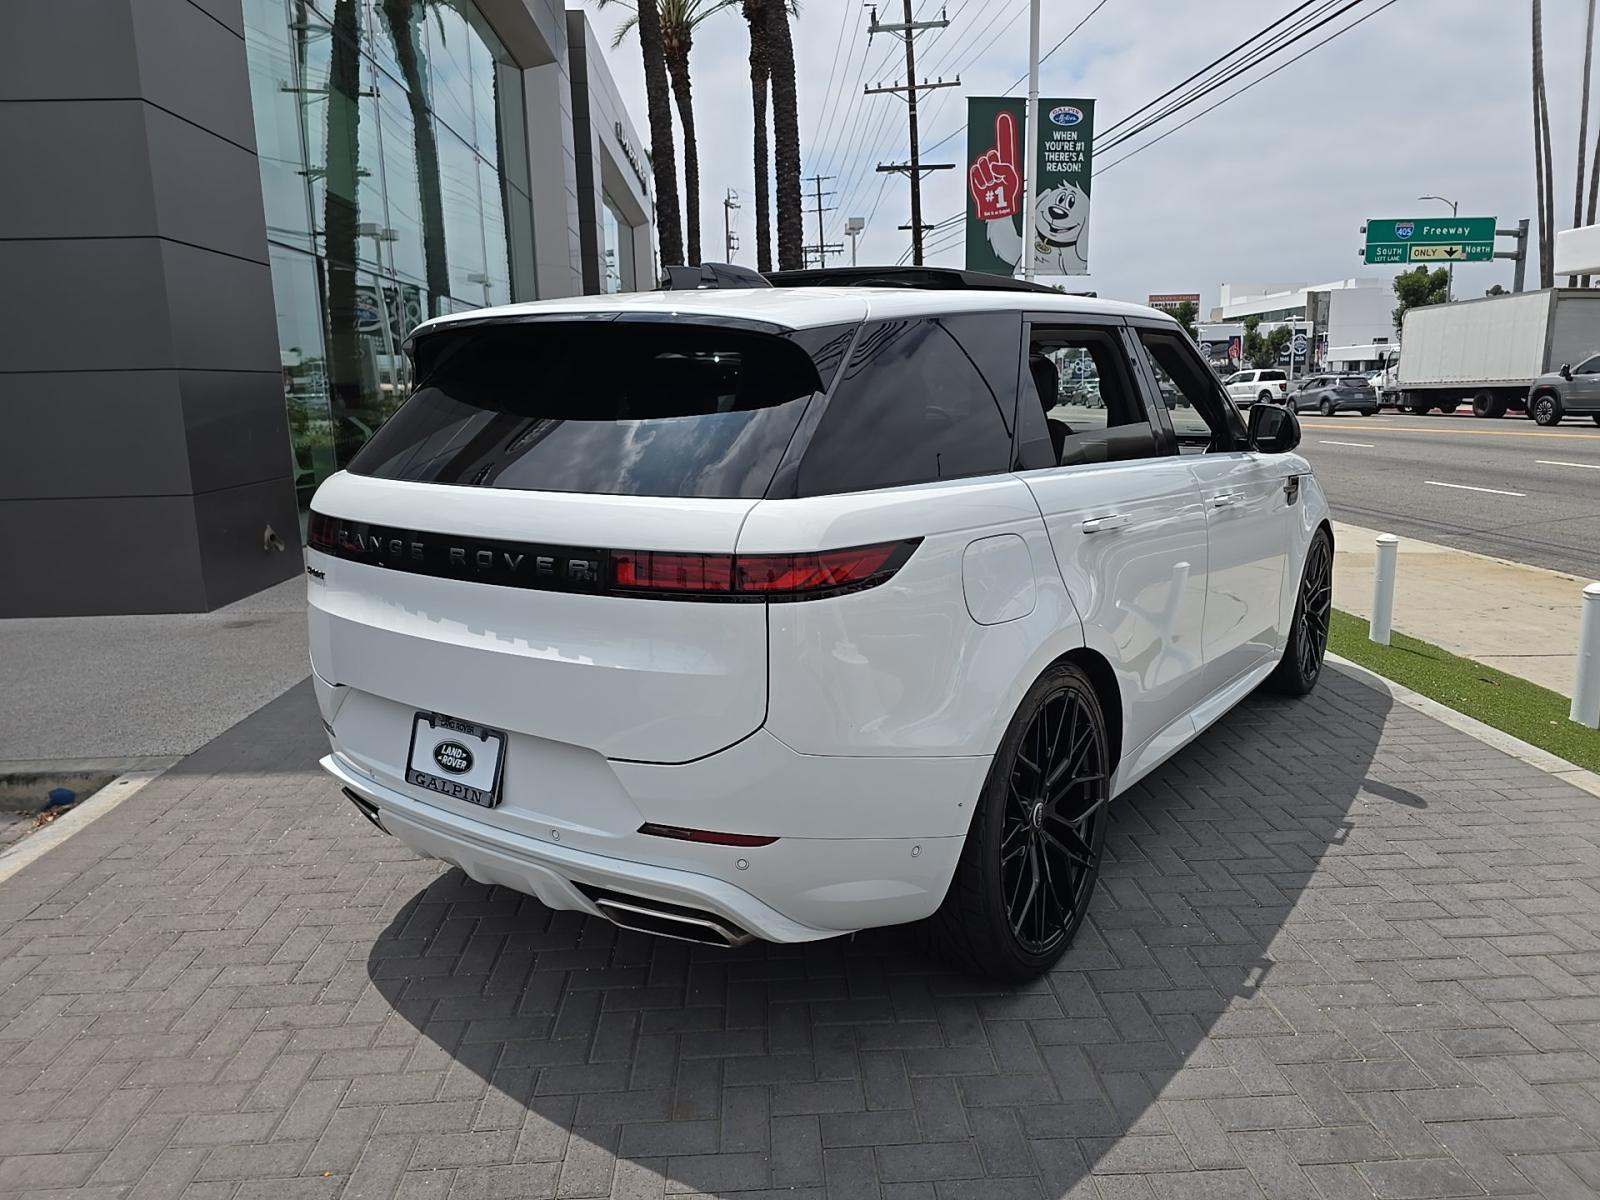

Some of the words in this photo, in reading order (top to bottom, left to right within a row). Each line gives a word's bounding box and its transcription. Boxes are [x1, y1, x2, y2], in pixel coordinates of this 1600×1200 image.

[1053, 131, 1078, 140] WHEN
[1045, 141, 1075, 151] YOU'RE
[1076, 142, 1085, 151] #1
[1045, 152, 1077, 161] THERE'S
[1078, 152, 1084, 161] A
[1046, 162, 1082, 172] REASON!
[985, 186, 1007, 207] #1
[1397, 227, 1412, 236] 405
[1423, 226, 1470, 236] Freeway
[1413, 248, 1438, 257] ONLY
[339, 529, 424, 559] RANGE
[450, 547, 590, 578] ROVER
[441, 744, 462, 758] LAND
[441, 755, 467, 770] ROVER
[415, 773, 484, 803] GALPIN
